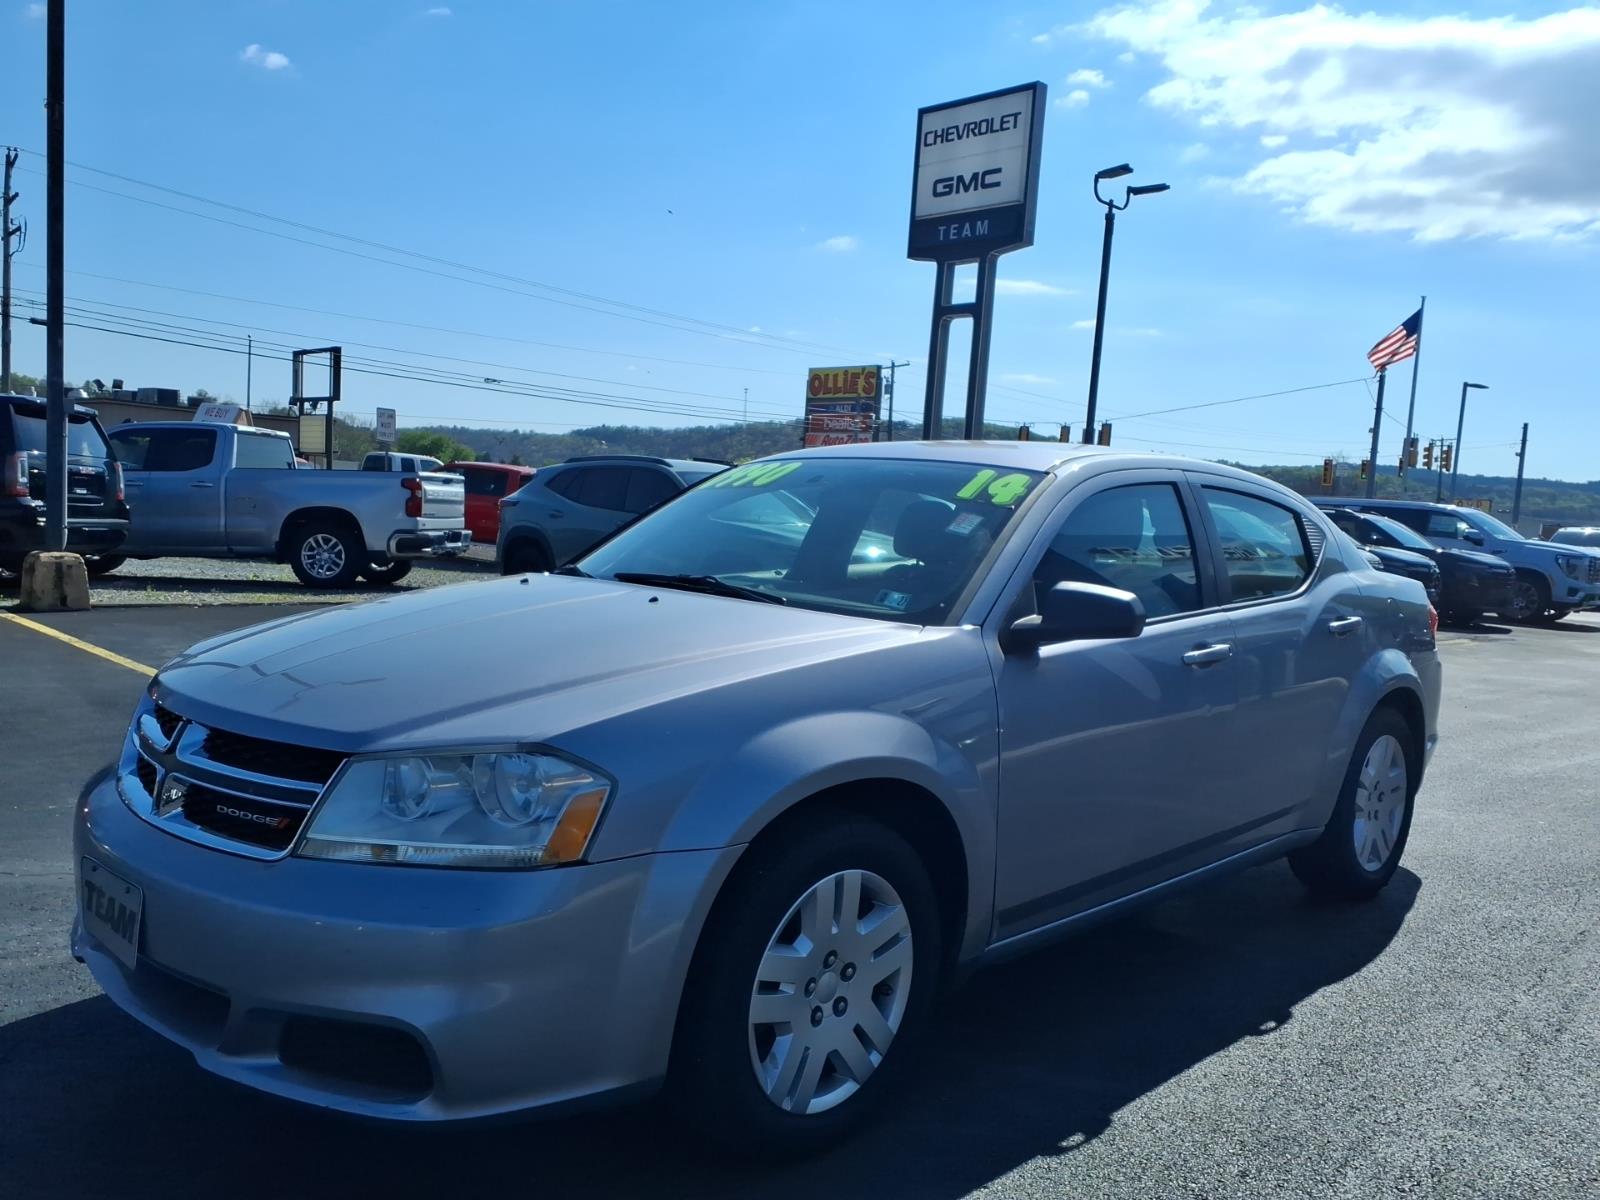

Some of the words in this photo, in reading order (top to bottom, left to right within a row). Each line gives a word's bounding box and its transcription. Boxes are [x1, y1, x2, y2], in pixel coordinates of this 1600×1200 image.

[923, 111, 1022, 148] CHEVROLET
[932, 167, 1003, 198] GMC
[938, 219, 990, 241] TEAM
[954, 469, 1032, 505] 14
[216, 804, 280, 826] DODGE
[84, 879, 137, 945] TEAM
